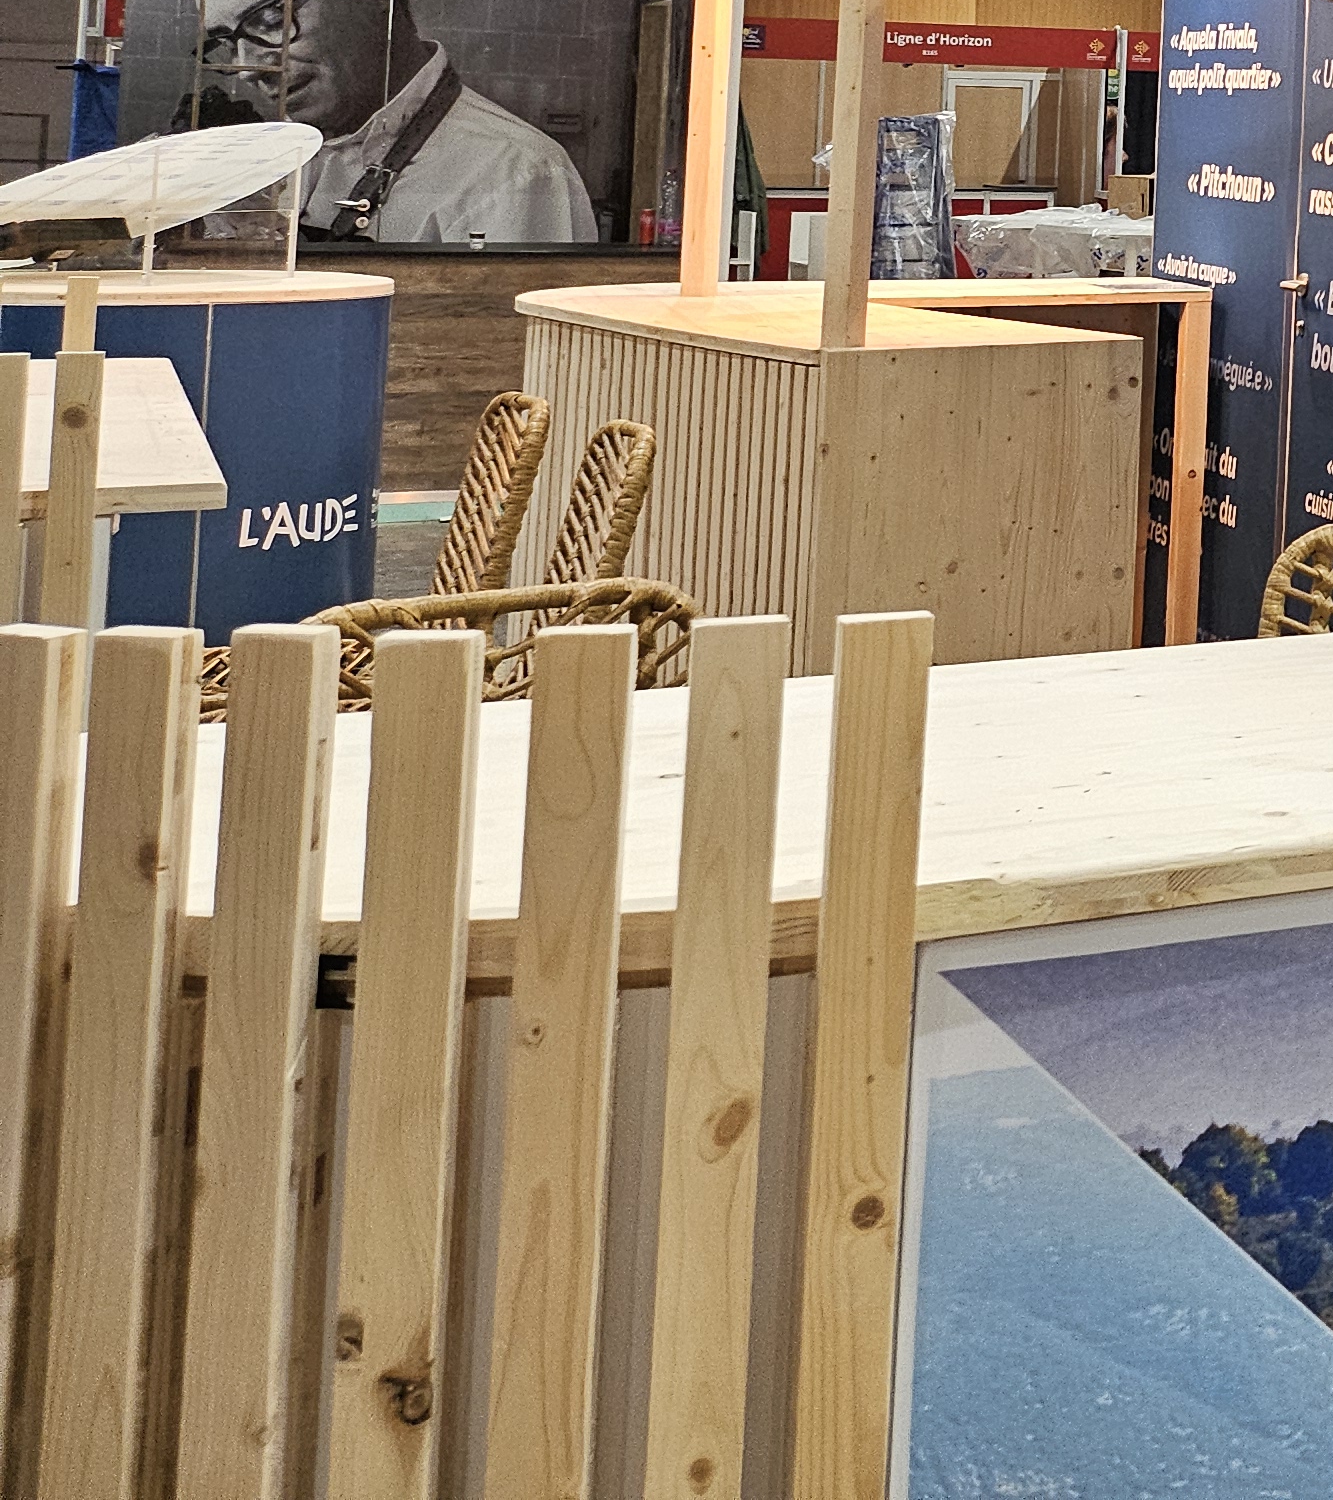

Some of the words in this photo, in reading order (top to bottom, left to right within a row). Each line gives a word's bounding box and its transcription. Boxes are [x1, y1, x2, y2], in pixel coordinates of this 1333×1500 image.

[886, 31, 924, 47] Ligne
[926, 32, 992, 48] d'Horizon
[1225, 62, 1272, 96] quartier
[1199, 165, 1262, 203] Pitchoun
[1165, 253, 1188, 276] Avoir
[1188, 256, 1199, 279] la
[1219, 446, 1238, 480] du
[238, 493, 359, 550] L'AUDE
[1219, 494, 1238, 529] du
